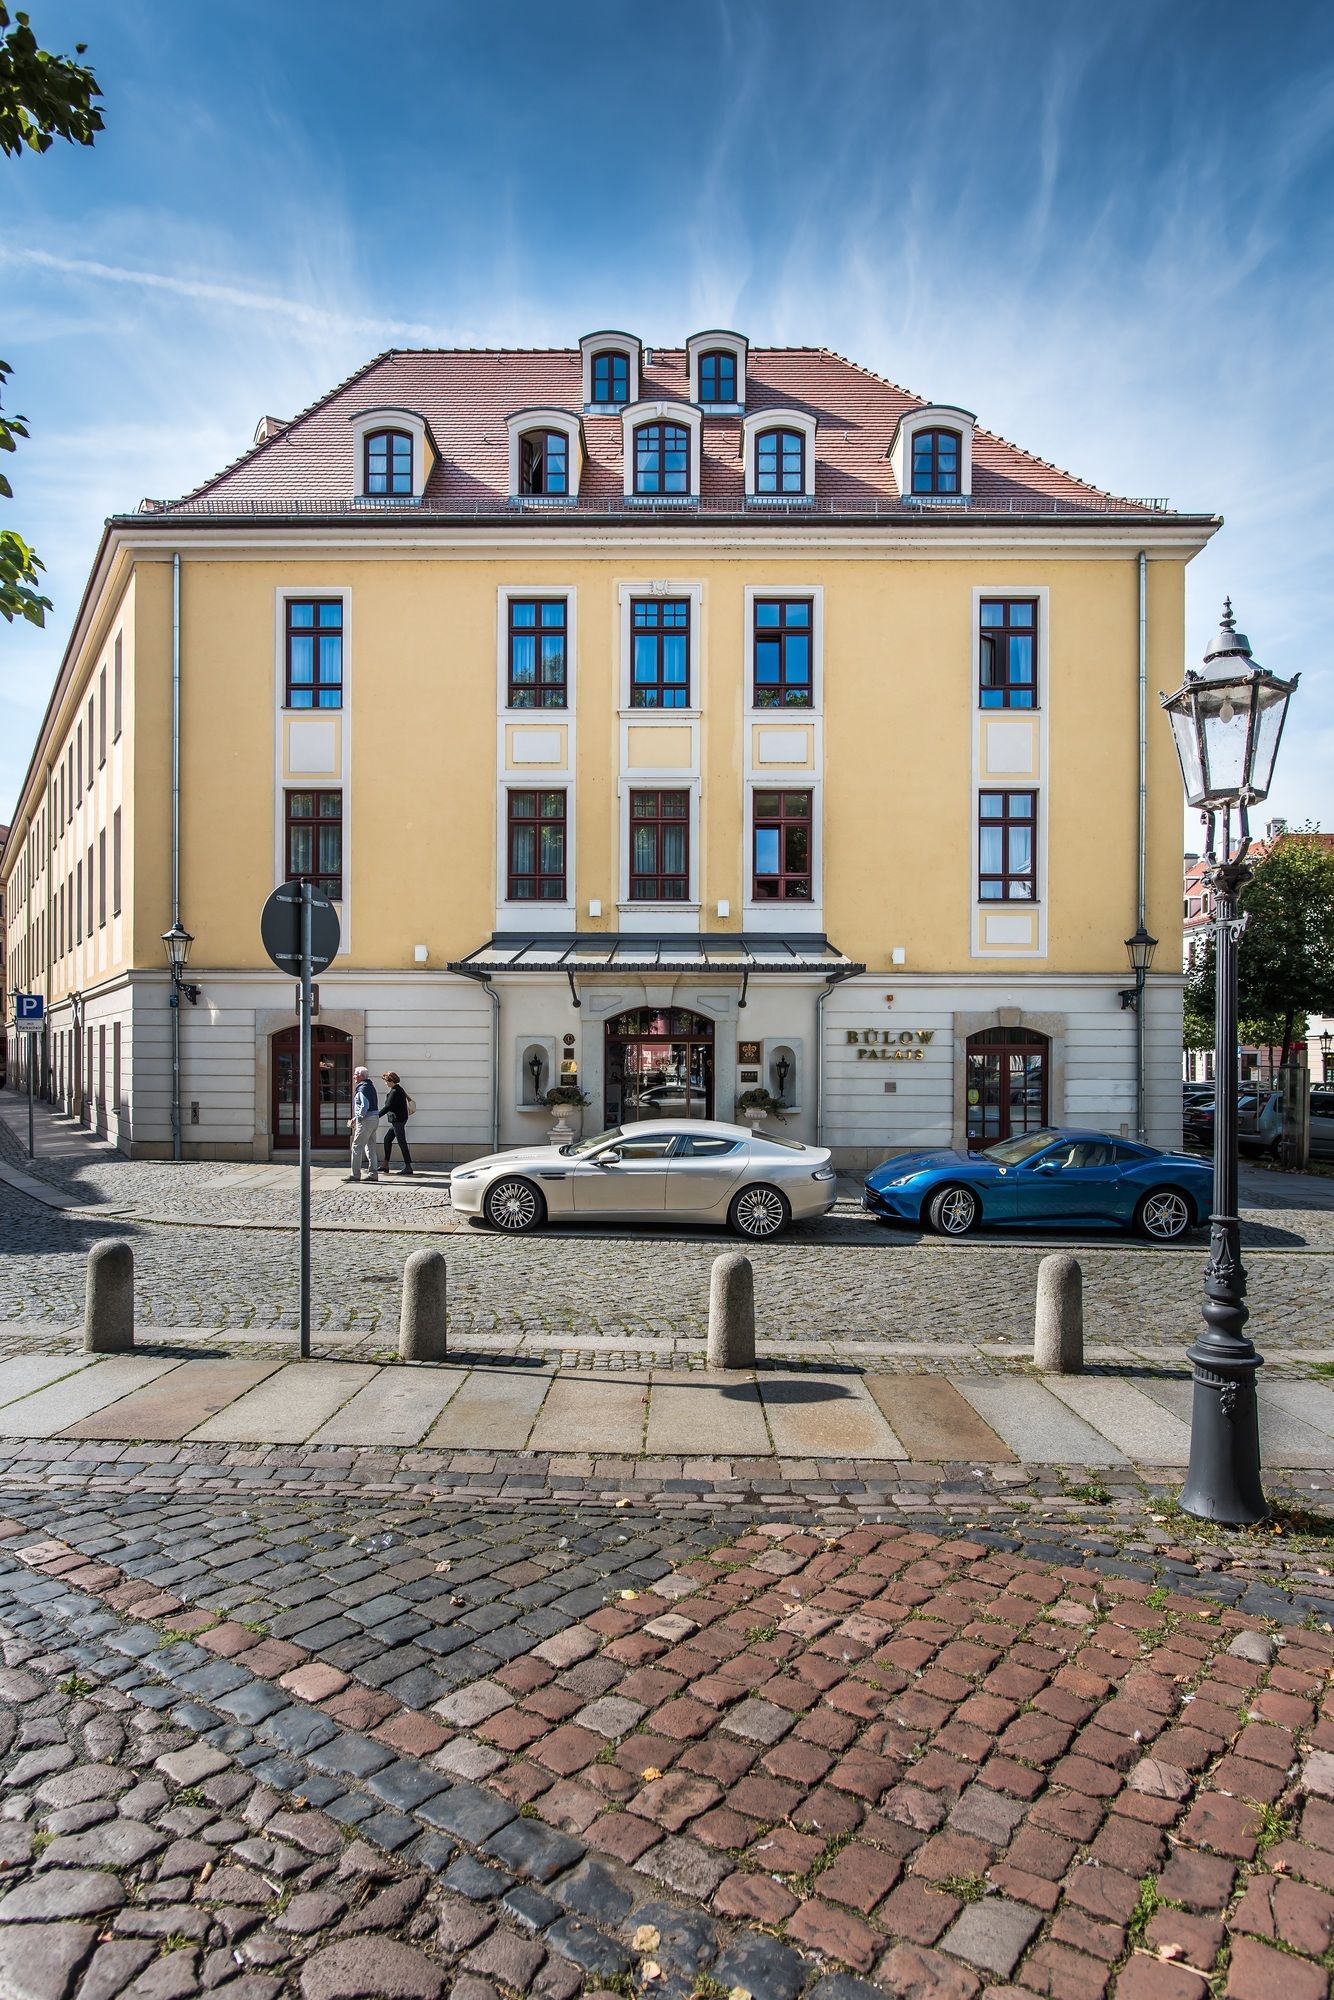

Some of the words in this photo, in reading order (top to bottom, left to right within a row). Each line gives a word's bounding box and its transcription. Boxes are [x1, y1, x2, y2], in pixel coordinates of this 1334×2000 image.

[23, 998, 38, 1016] P
[846, 1028, 934, 1045] BÜLOW
[858, 1048, 924, 1060] PALAIS
